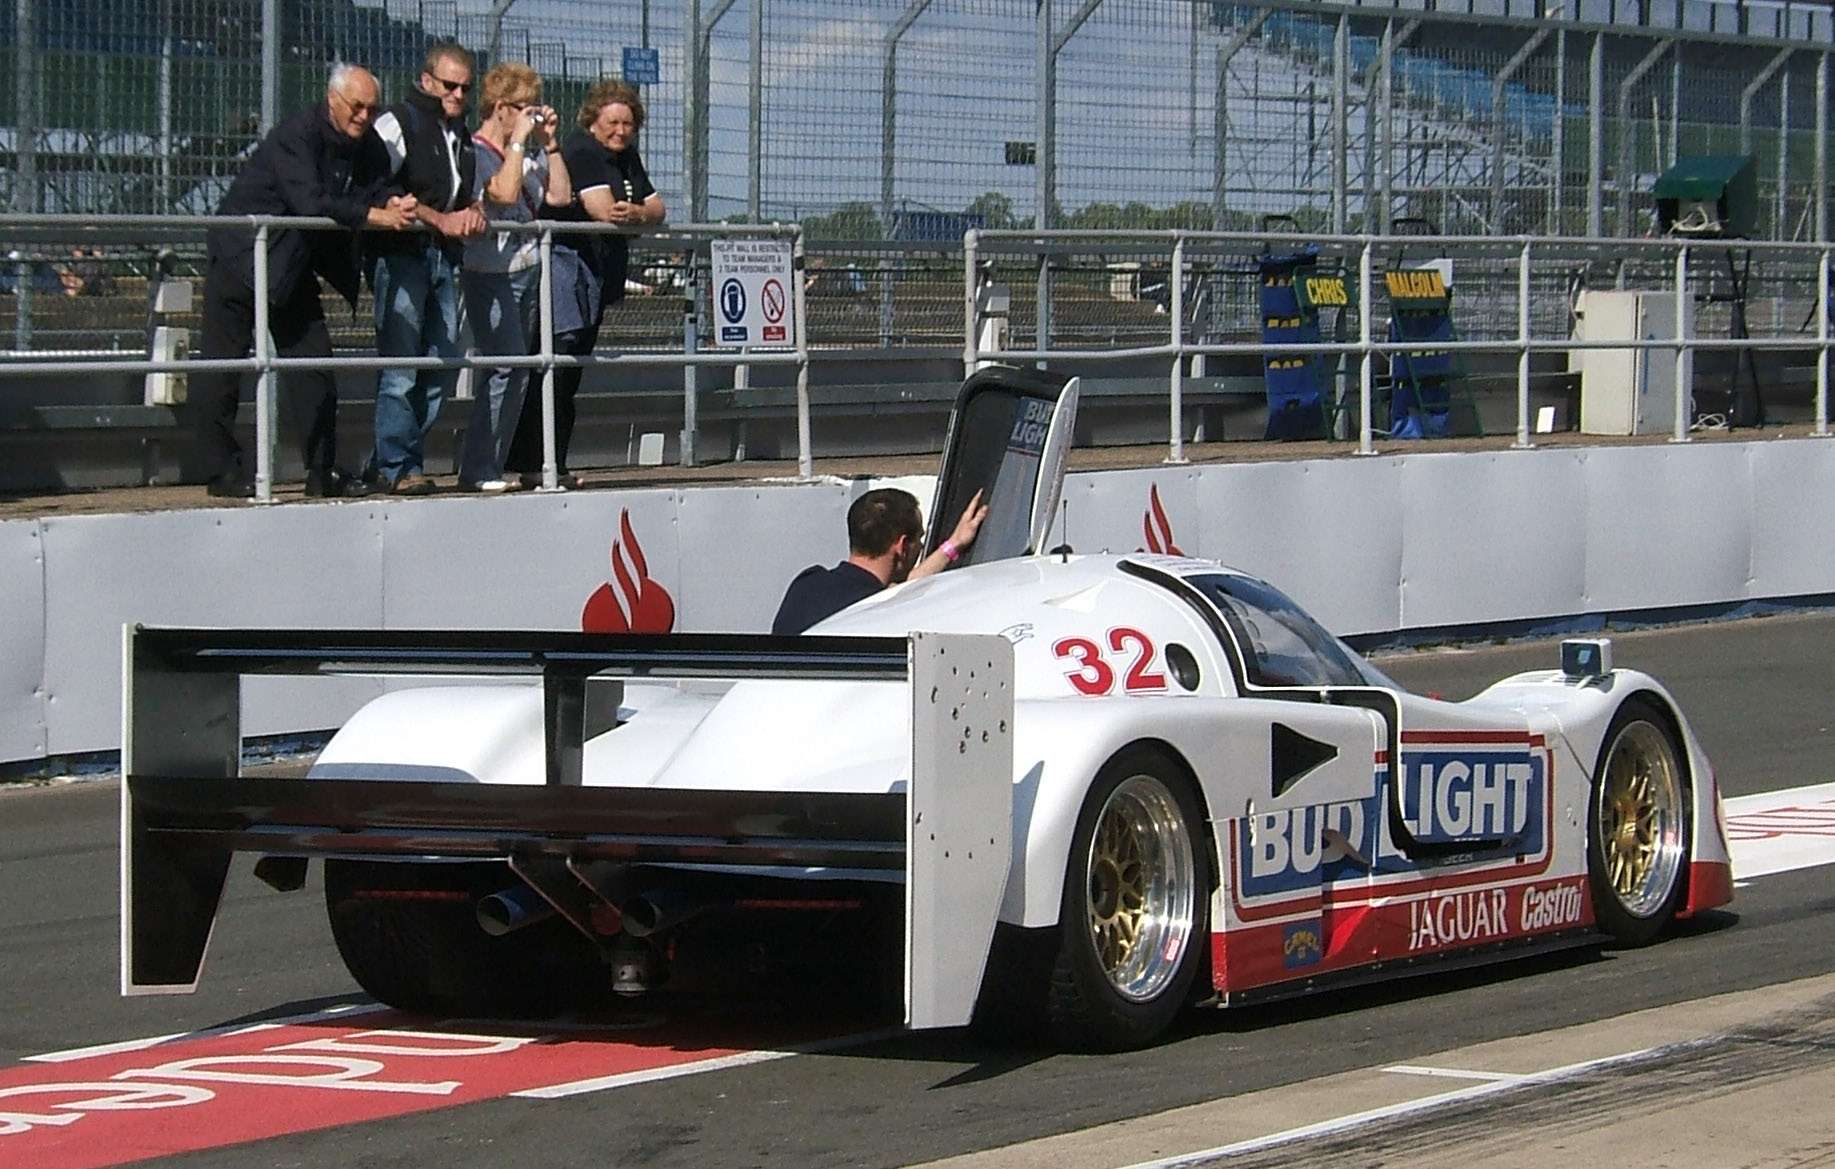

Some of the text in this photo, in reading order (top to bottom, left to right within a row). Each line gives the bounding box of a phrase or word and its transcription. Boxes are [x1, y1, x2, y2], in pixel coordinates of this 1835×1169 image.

[724, 264, 739, 273] TEAM
[731, 254, 746, 263] TEAM
[1306, 277, 1349, 305] CHRIS
[1385, 271, 1447, 298] MALCOLM
[1010, 420, 1048, 446] LIGH
[1051, 625, 1168, 698] 32
[1251, 760, 1532, 879] BUD LIGHT
[1409, 879, 1586, 951] JAGUAR Castrol
